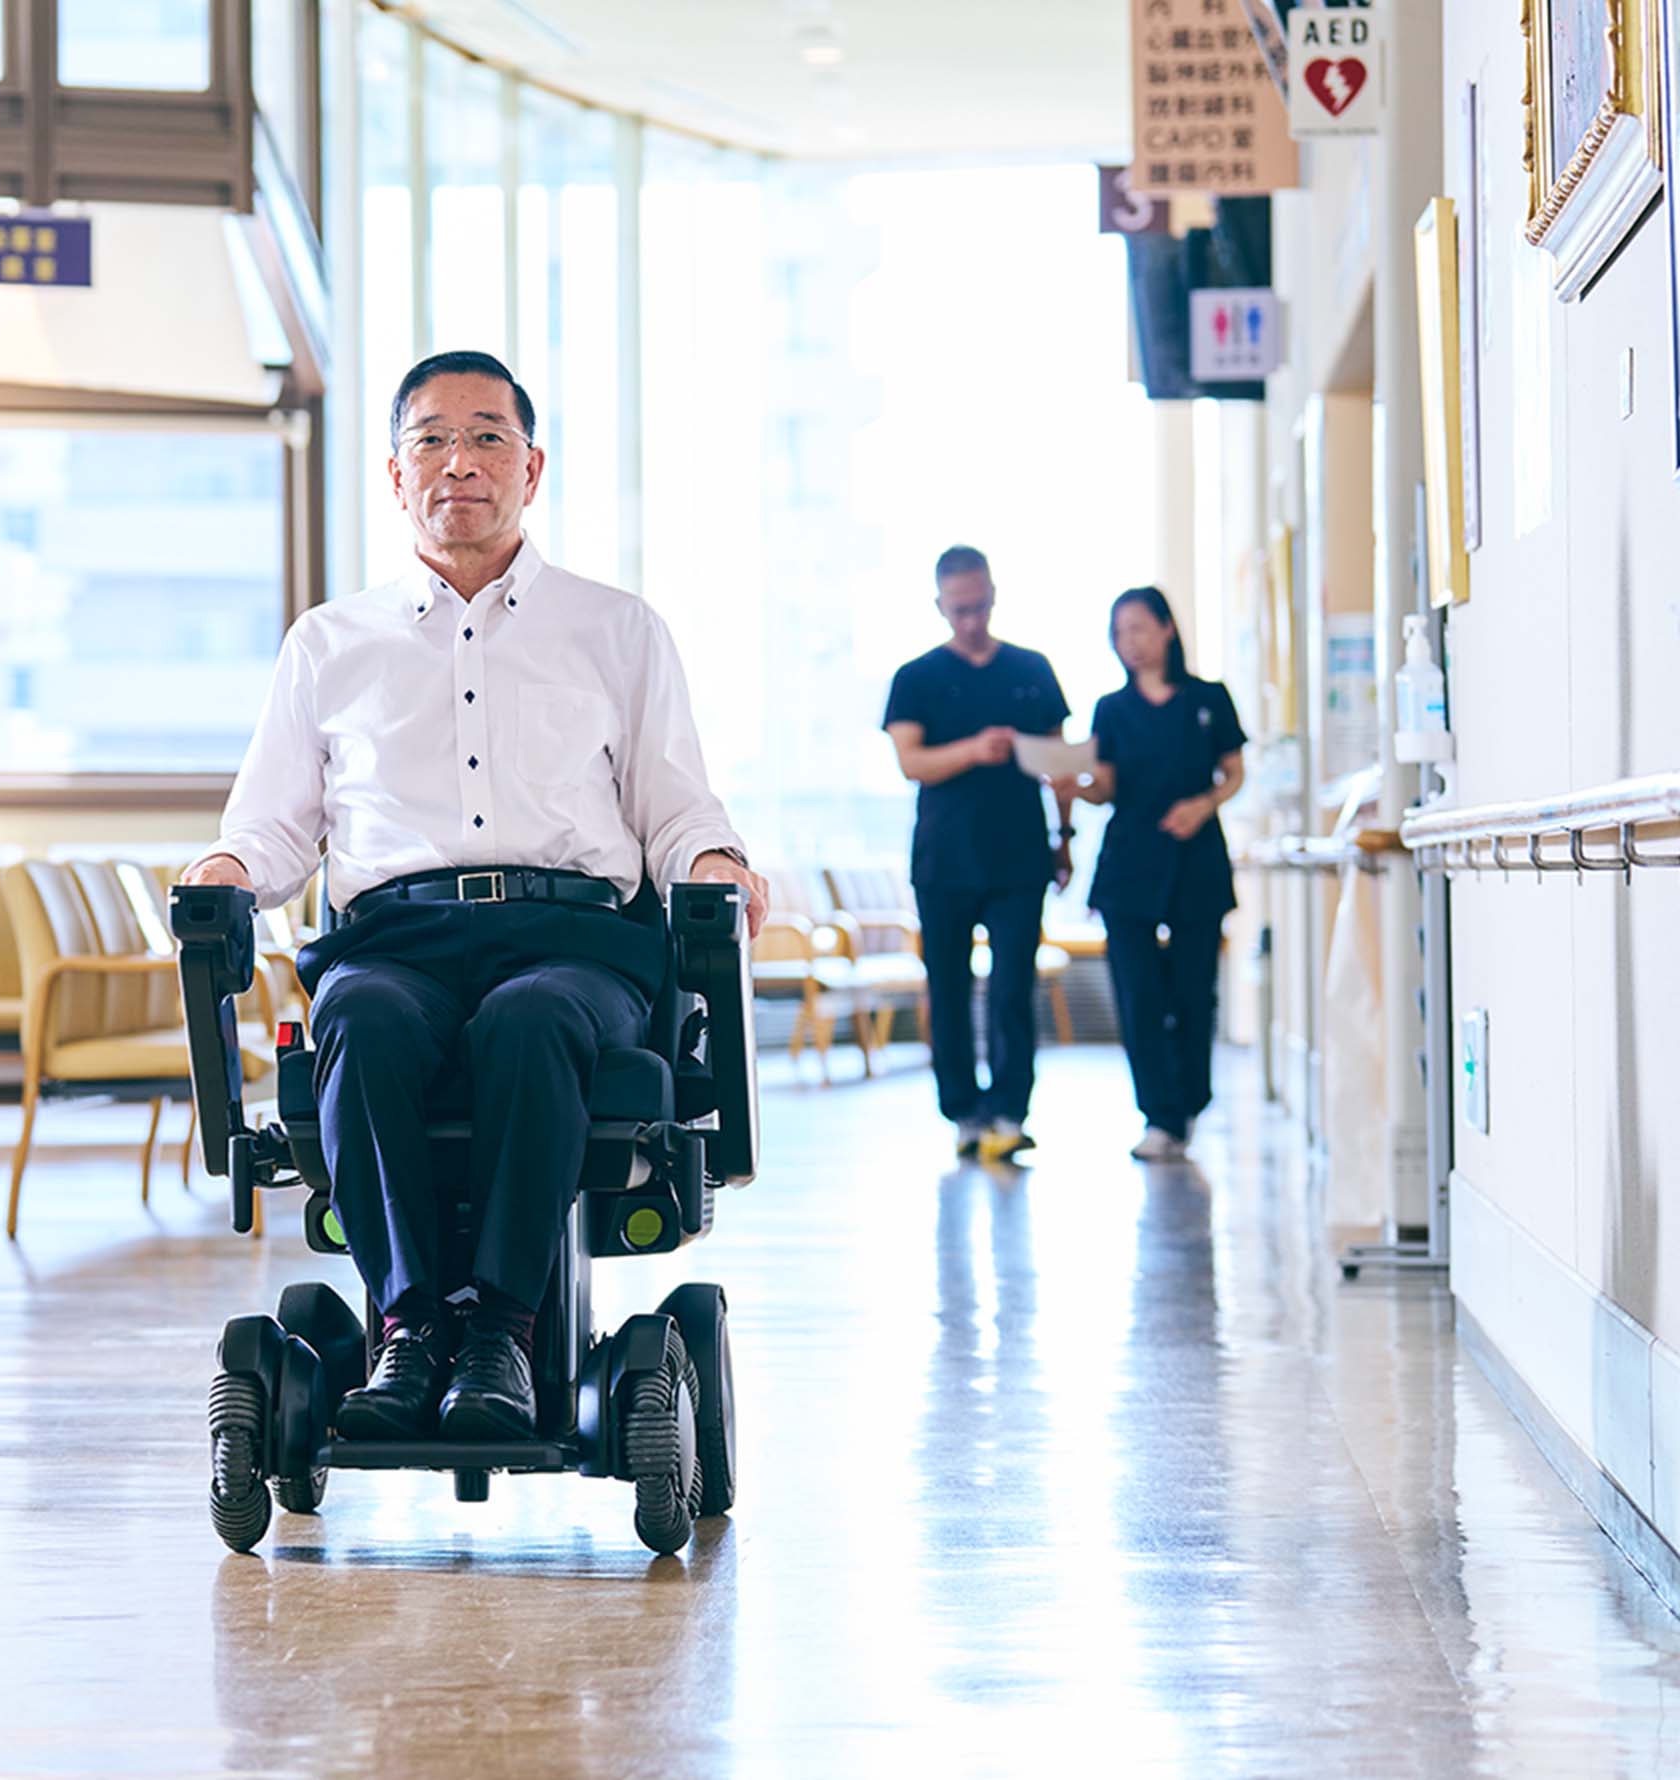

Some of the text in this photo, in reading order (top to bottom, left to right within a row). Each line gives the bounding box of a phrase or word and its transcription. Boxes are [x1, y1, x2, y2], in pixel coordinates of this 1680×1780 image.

[1303, 18, 1368, 45] AED
[1148, 95, 1255, 118] 放射線科
